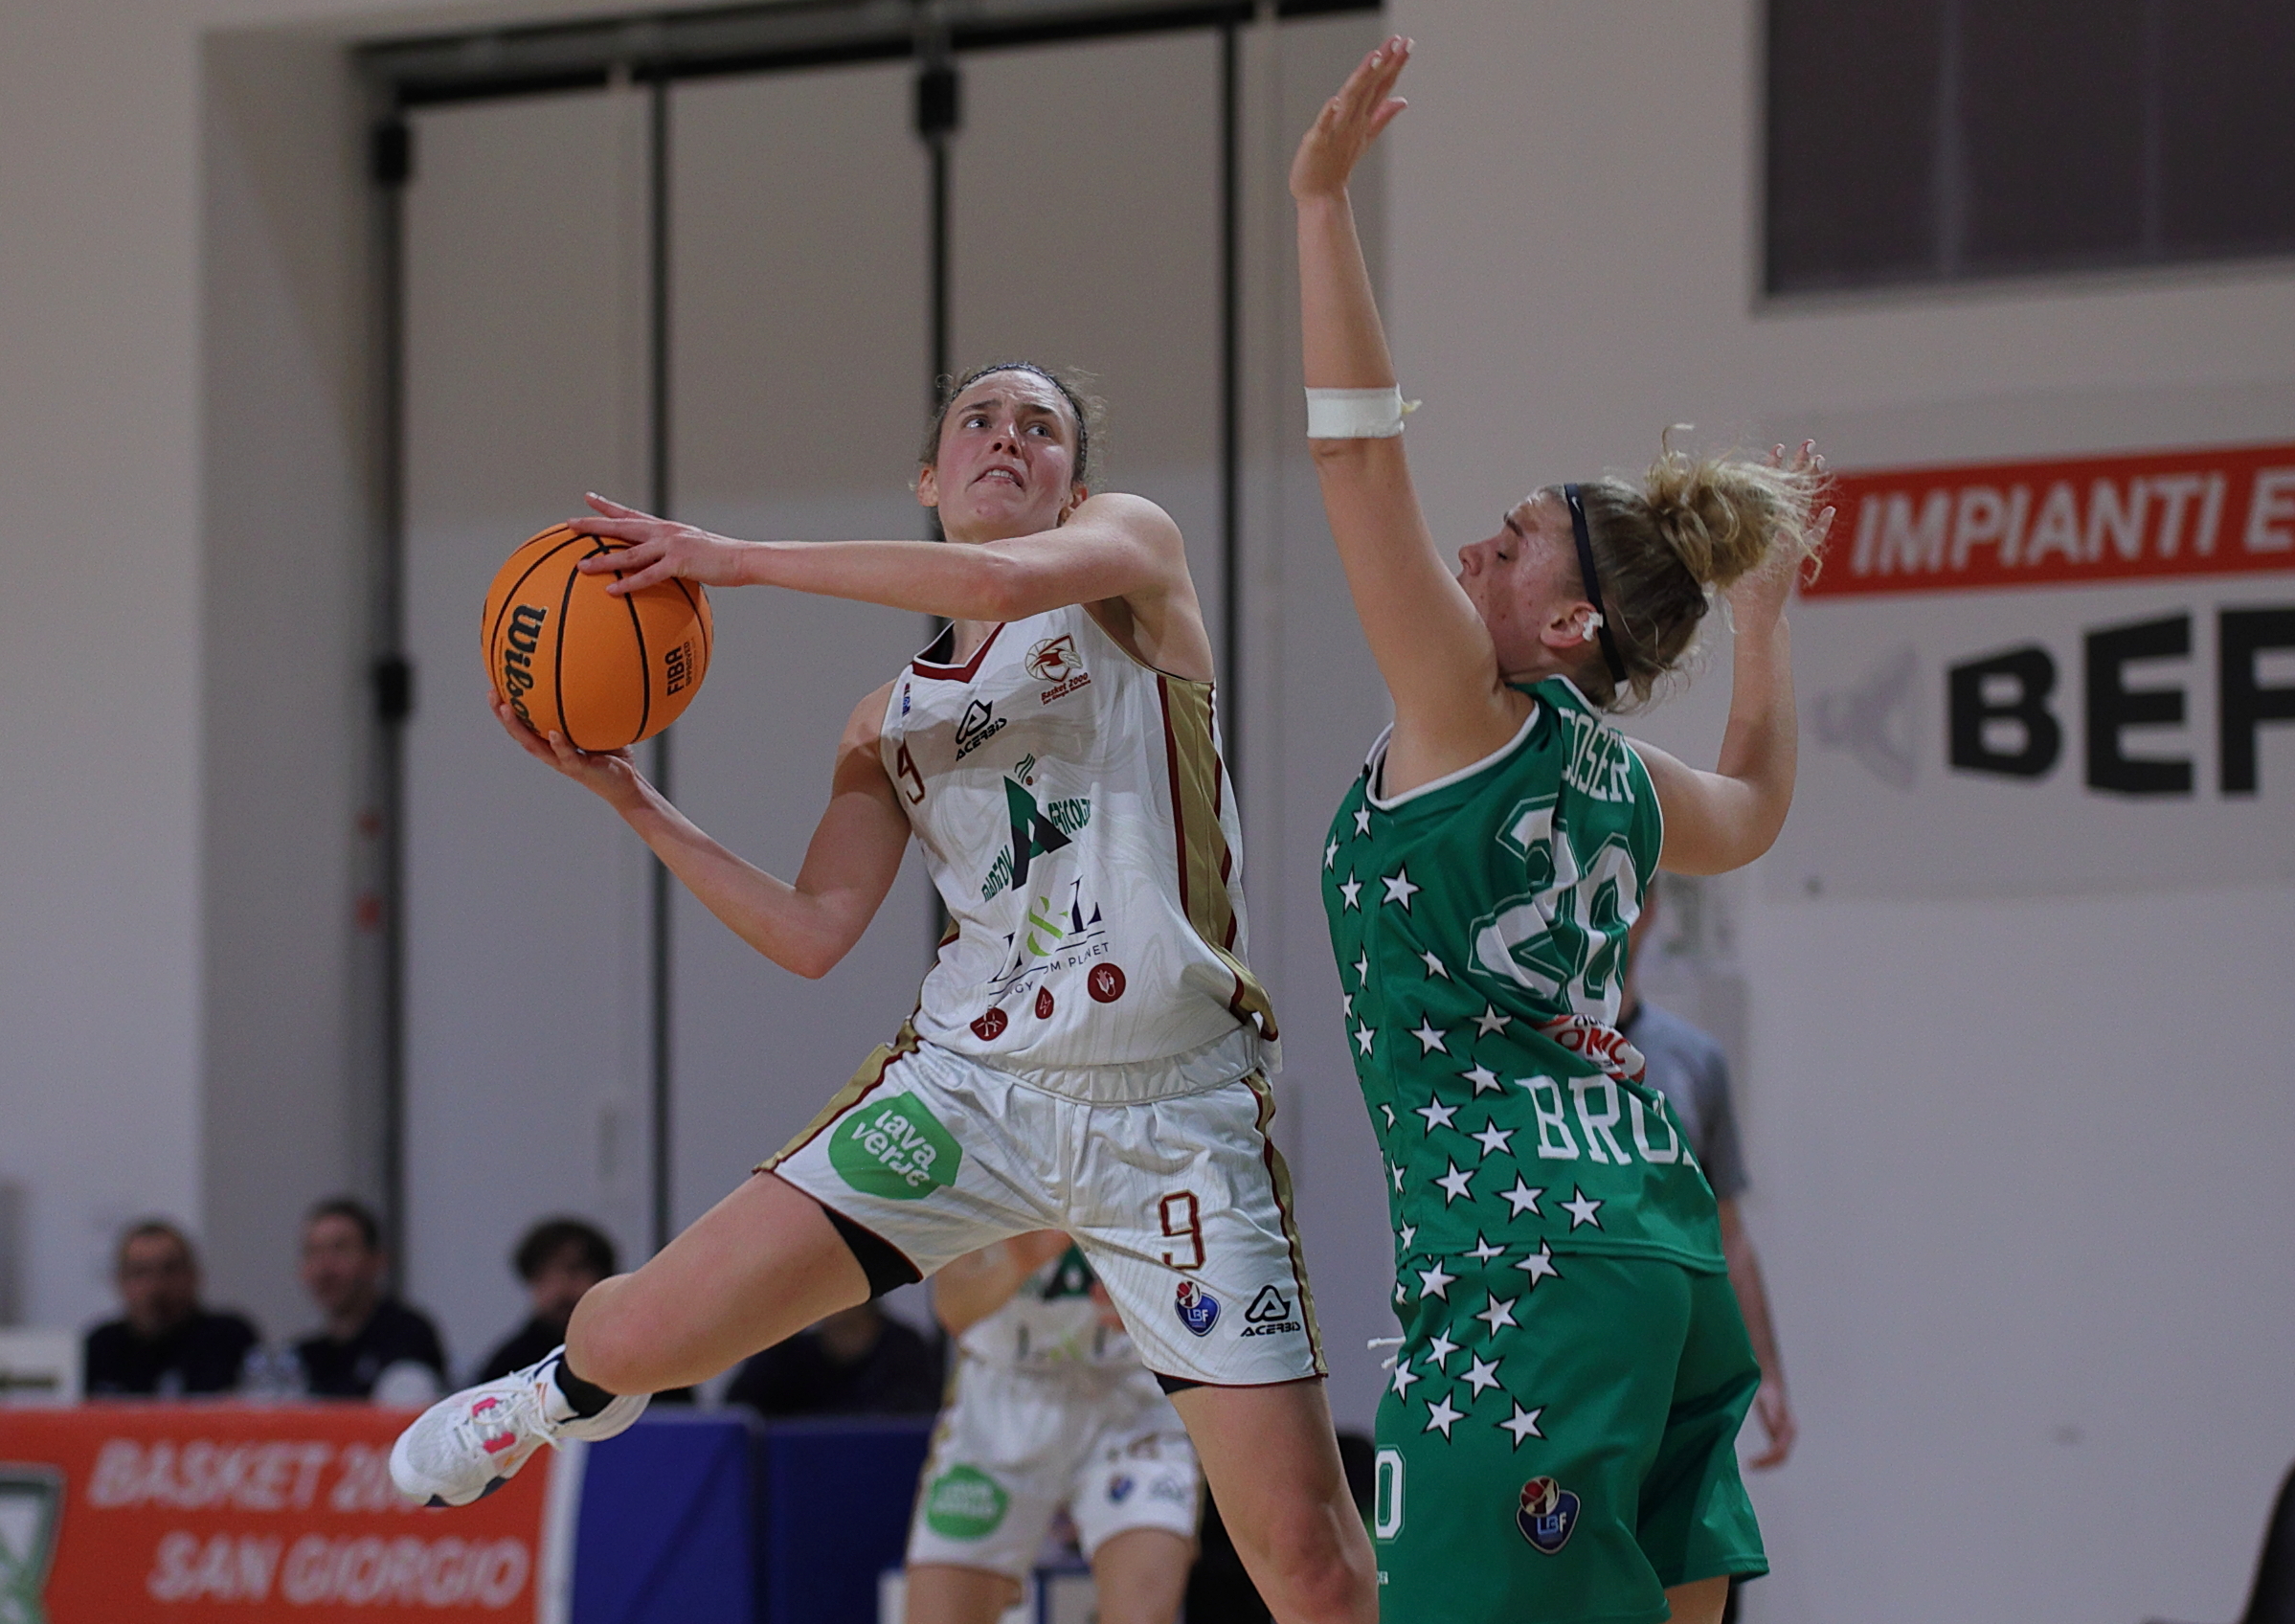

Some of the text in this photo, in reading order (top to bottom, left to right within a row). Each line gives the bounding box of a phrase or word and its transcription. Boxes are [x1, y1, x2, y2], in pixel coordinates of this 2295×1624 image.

[1850, 471, 2227, 575] IMPIANTI
[664, 645, 686, 696] FIBA
[1069, 671, 1089, 688] 2000
[1554, 1026, 1631, 1065] OMC
[1514, 1073, 1700, 1174] BRO
[1158, 1188, 1206, 1272] 9
[1187, 1307, 1208, 1322] LBF
[88, 1438, 331, 1510] BASKET
[1537, 1511, 1567, 1535] LBF
[147, 1531, 530, 1608] SAN GIORGIO
